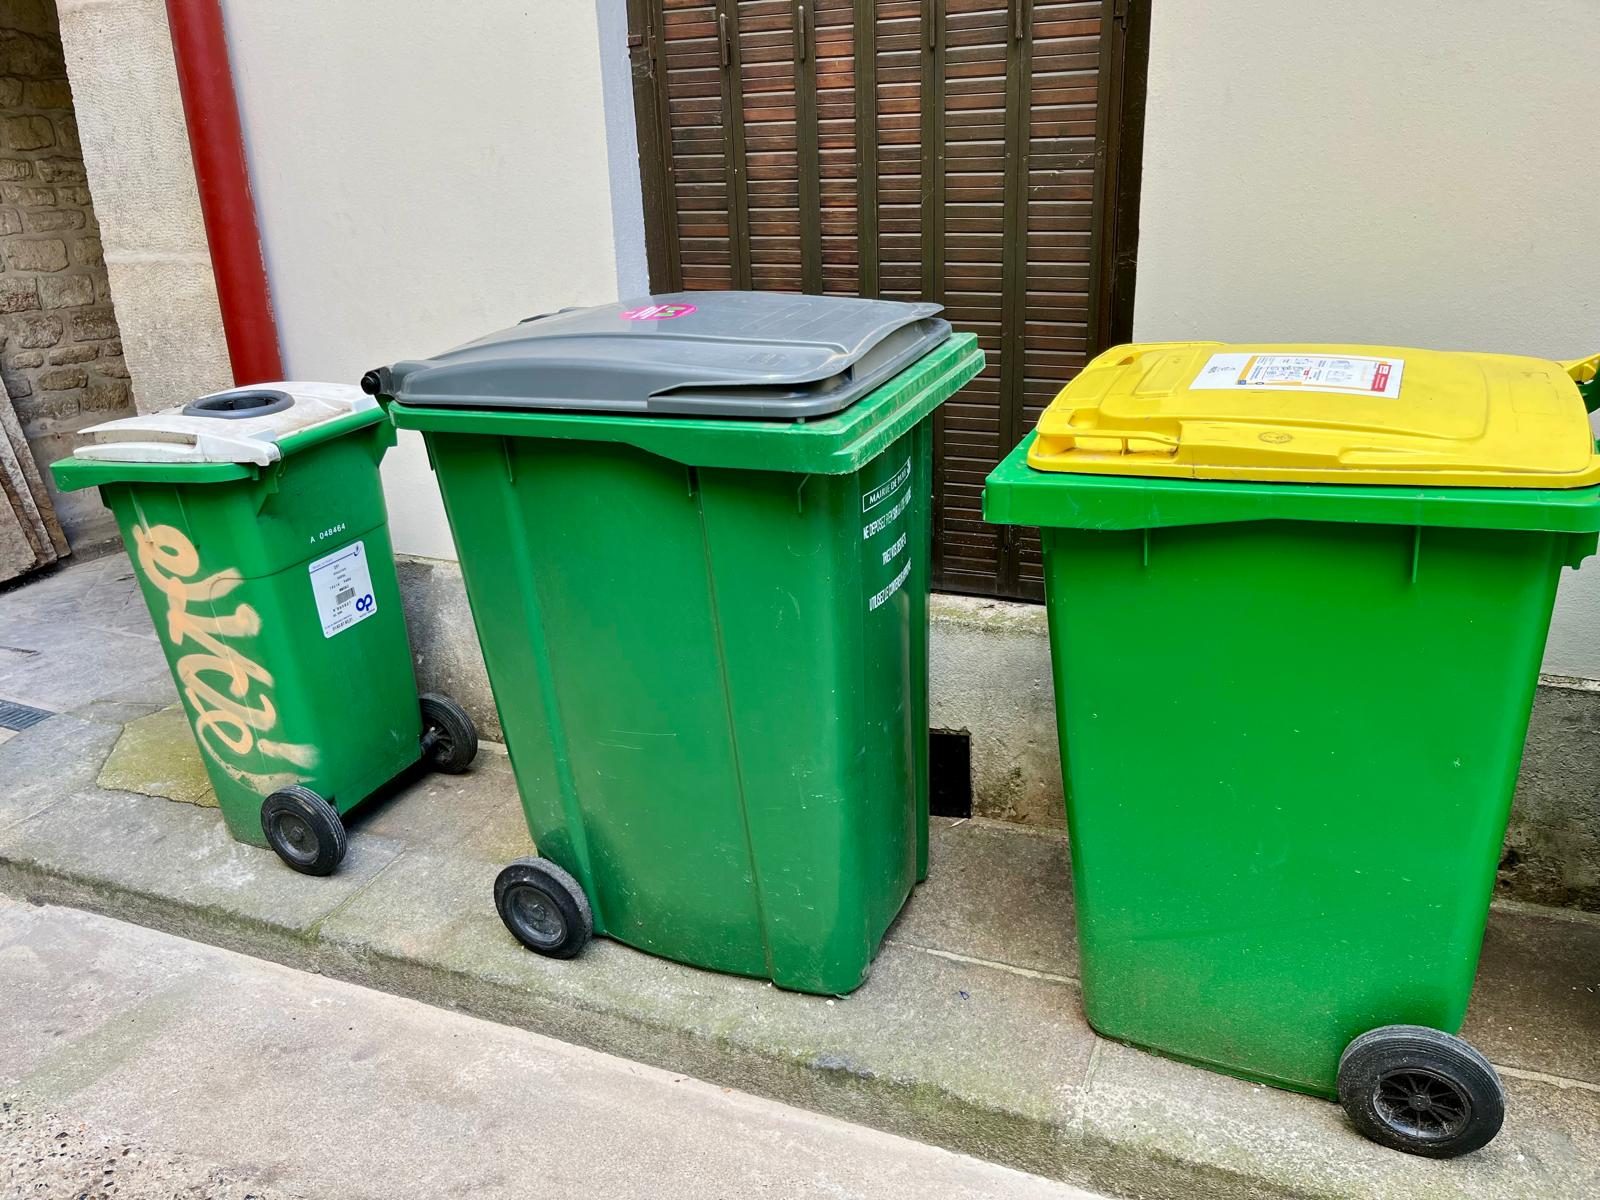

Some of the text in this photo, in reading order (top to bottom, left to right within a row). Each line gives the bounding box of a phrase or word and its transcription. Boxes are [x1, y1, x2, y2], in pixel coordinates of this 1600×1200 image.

[869, 484, 891, 504] MAIRIE
[890, 478, 898, 490] DE
[310, 522, 346, 544] A 048464
